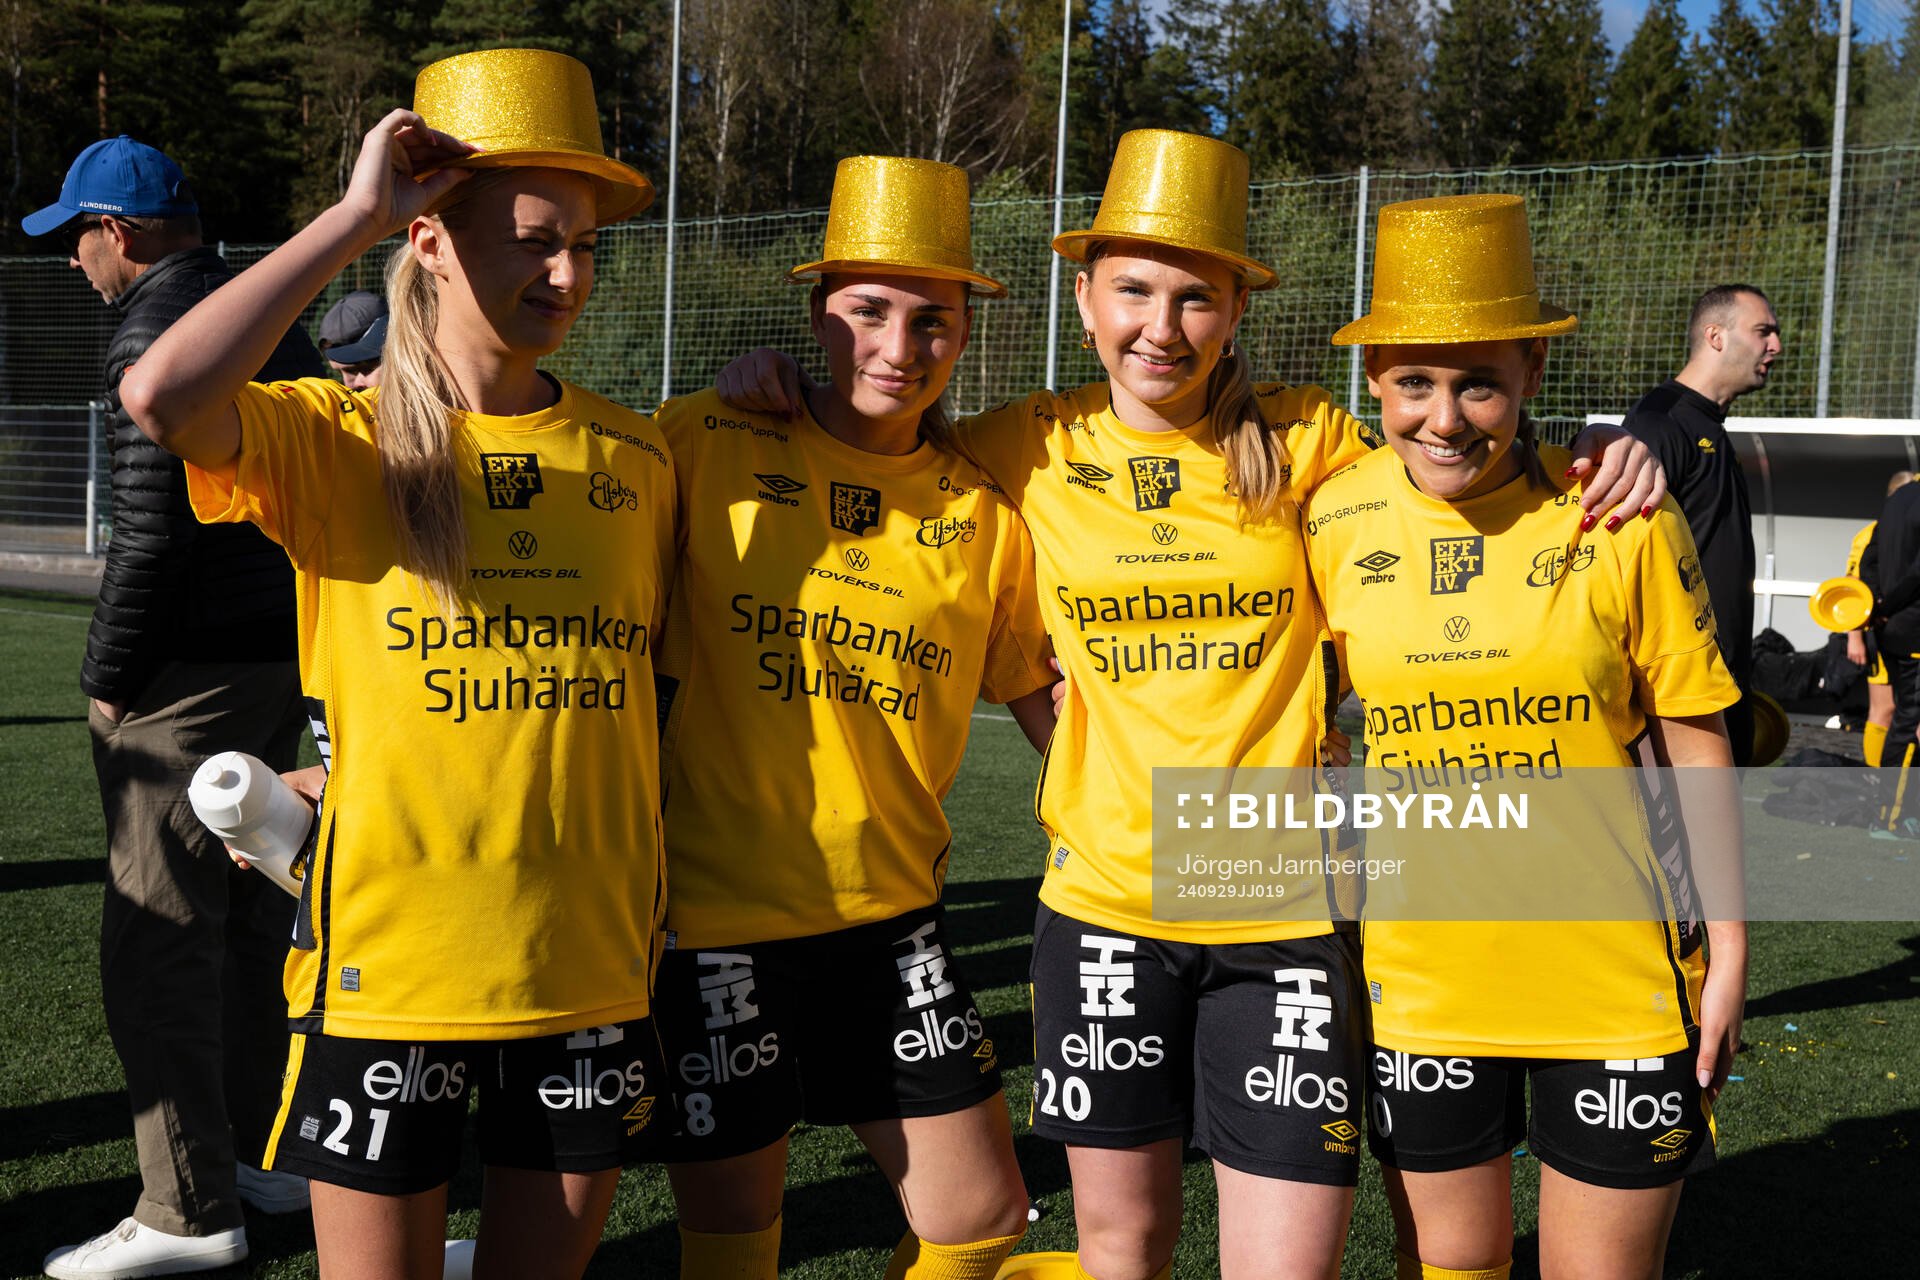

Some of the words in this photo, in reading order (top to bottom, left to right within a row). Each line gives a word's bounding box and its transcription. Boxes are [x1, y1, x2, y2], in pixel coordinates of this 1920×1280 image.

[605, 428, 668, 468] RO-GRUPPEN
[757, 490, 800, 507] umbro
[1066, 474, 1107, 495] umbro
[1317, 499, 1388, 528] RO-GRUPPEN
[469, 568, 553, 579] TOVEKS
[555, 568, 583, 579] BIL
[807, 566, 881, 592] TOVEKS
[882, 585, 905, 599] BIL
[1114, 552, 1190, 565] TOVEKS
[1193, 551, 1218, 562] BIL
[1360, 572, 1396, 586] umbro
[386, 603, 648, 661] Sparbanken
[1056, 582, 1296, 632] Sparbanken
[730, 593, 953, 678] Sparbanken
[1085, 631, 1267, 683] Sjuhärad
[1403, 649, 1482, 665] TOVEKS
[1485, 647, 1511, 660] BIL
[423, 665, 626, 723] Sjuhärad
[758, 651, 921, 722] Sjuhärad
[1379, 738, 1563, 797] Sjuhärad
[679, 1031, 780, 1087] ellos
[893, 1007, 984, 1063] ellos
[1061, 1023, 1165, 1071] ellos
[363, 1045, 466, 1103] ellos
[538, 1058, 646, 1110] ellos
[1040, 1067, 1092, 1122] 20
[1244, 1053, 1349, 1114] ellos
[1373, 1050, 1475, 1093] ellos
[321, 1098, 391, 1161] 21
[1574, 1077, 1683, 1130] ellos
[1324, 1140, 1356, 1155] umbro
